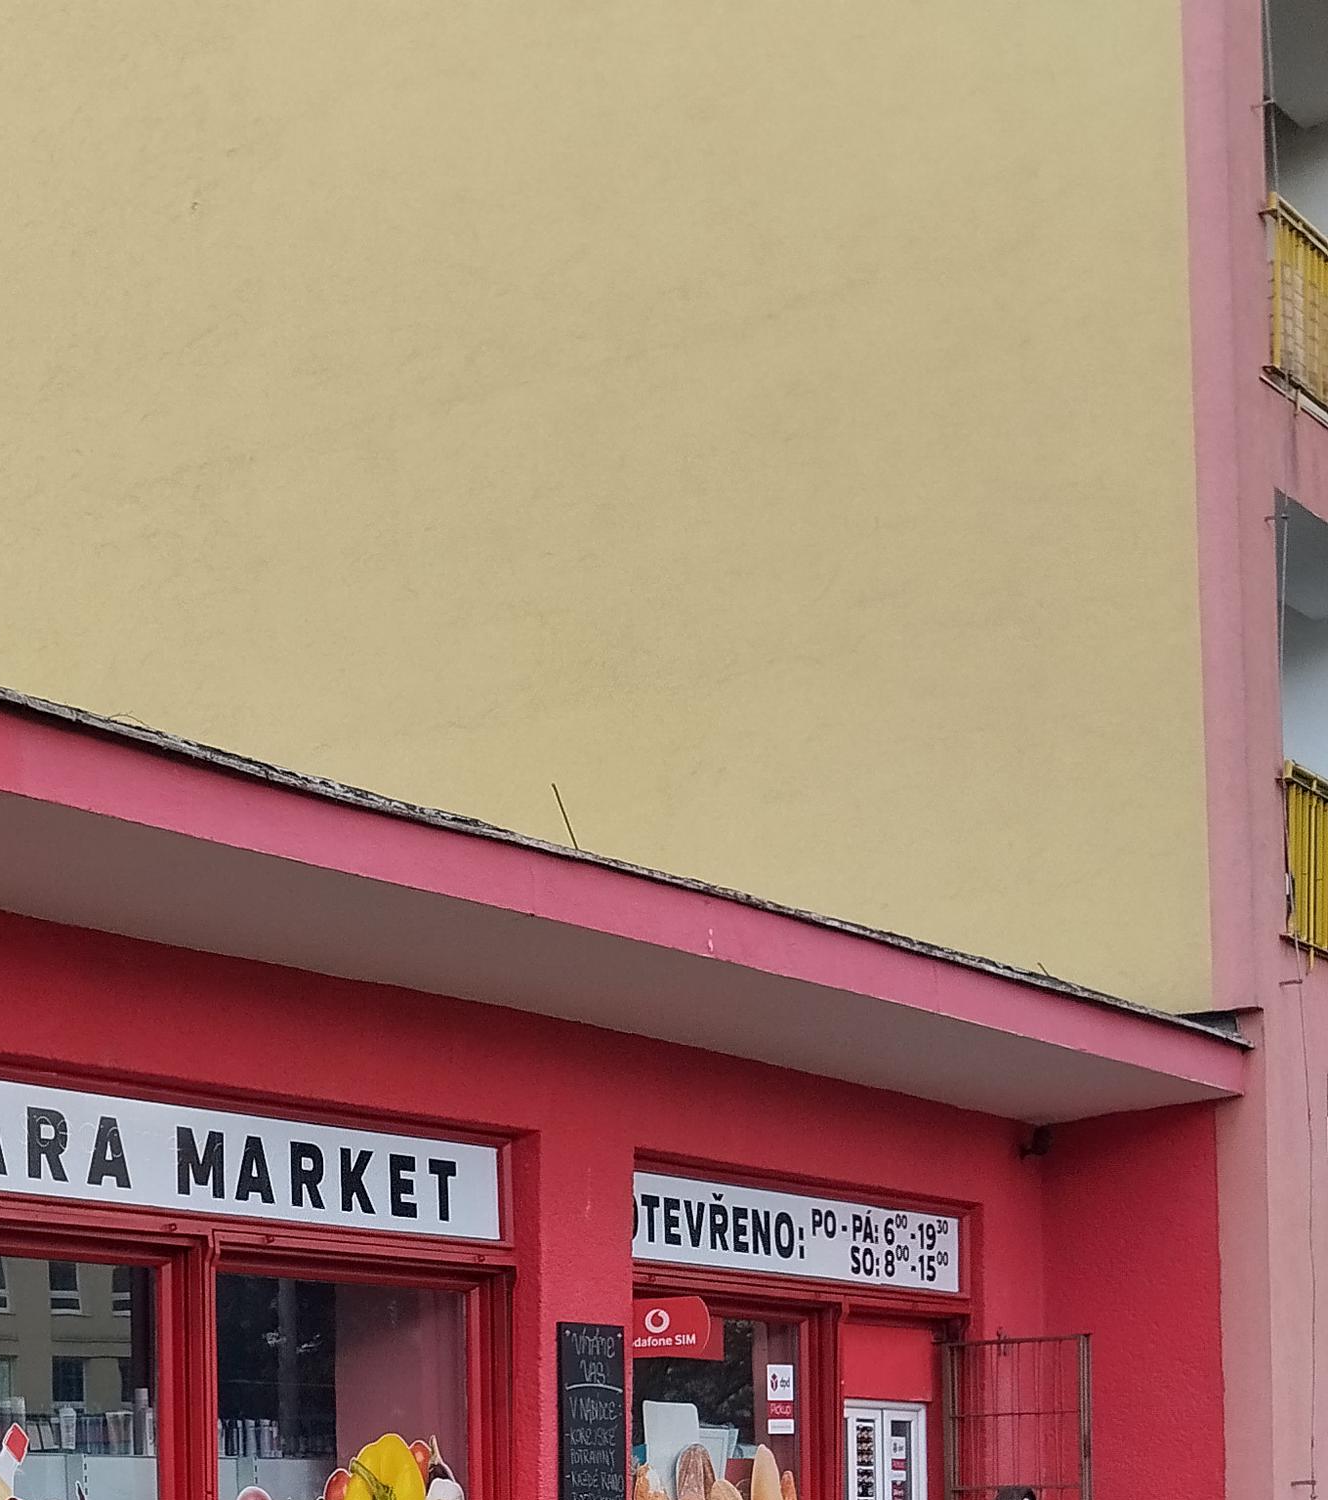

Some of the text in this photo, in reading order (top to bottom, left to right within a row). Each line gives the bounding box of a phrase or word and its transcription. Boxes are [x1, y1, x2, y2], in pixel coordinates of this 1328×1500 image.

[176, 1125, 457, 1222] MARKET
[850, 1246, 880, 1277] SO:
[632, 1334, 696, 1347] dafone SIM
